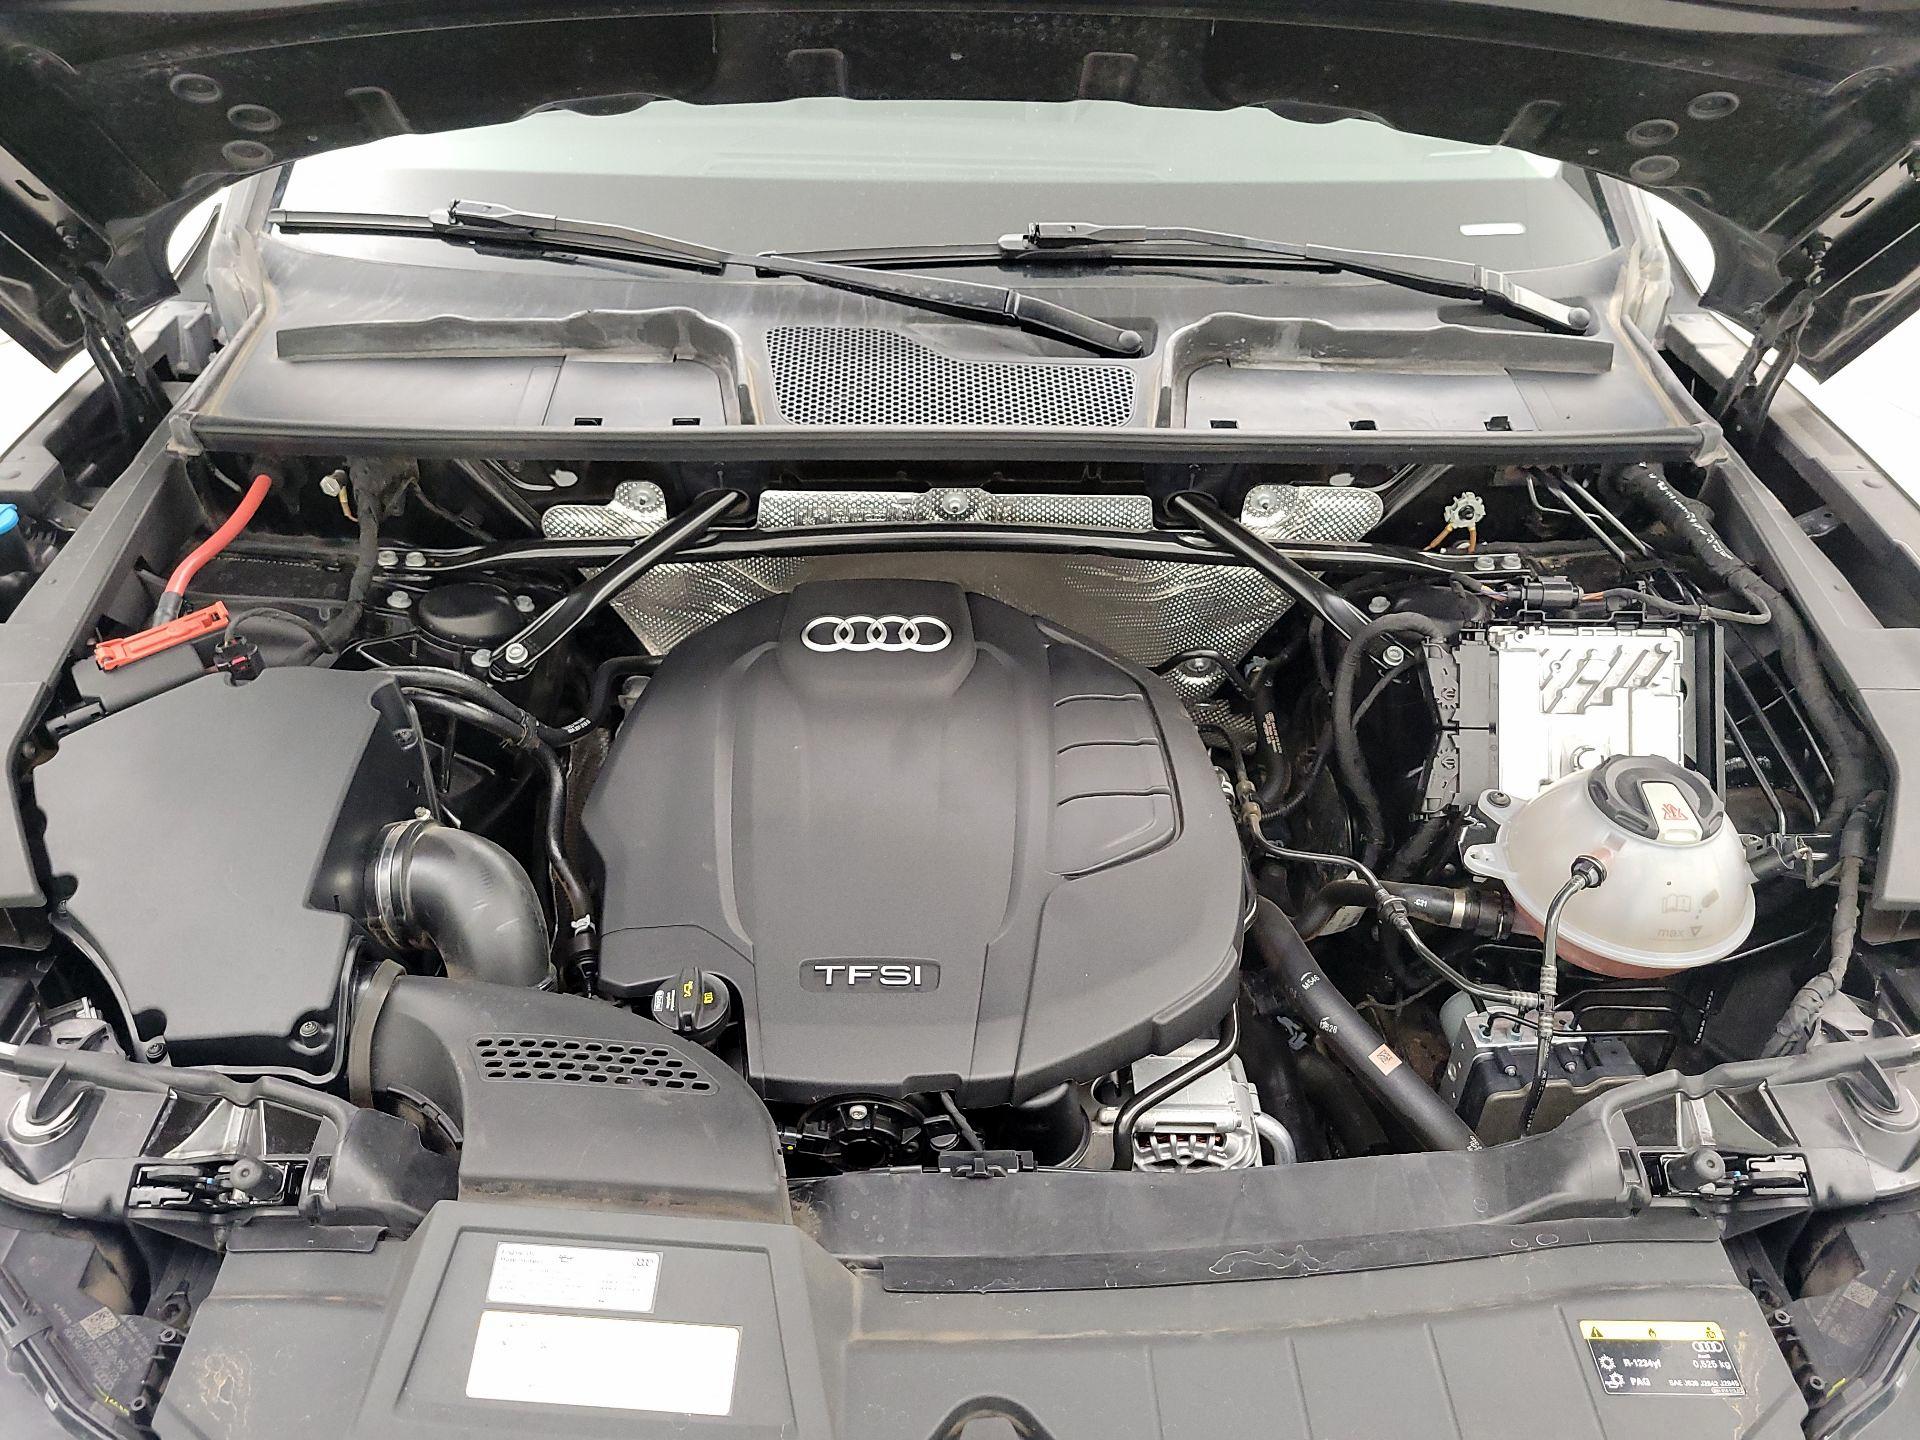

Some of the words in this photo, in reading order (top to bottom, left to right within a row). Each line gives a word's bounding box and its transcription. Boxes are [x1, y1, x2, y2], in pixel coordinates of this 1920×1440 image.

[1657, 928, 1684, 938] max
[814, 965, 922, 986] TFSI
[1719, 1360, 1731, 1370] kg
[1630, 1377, 1651, 1387] PAG
